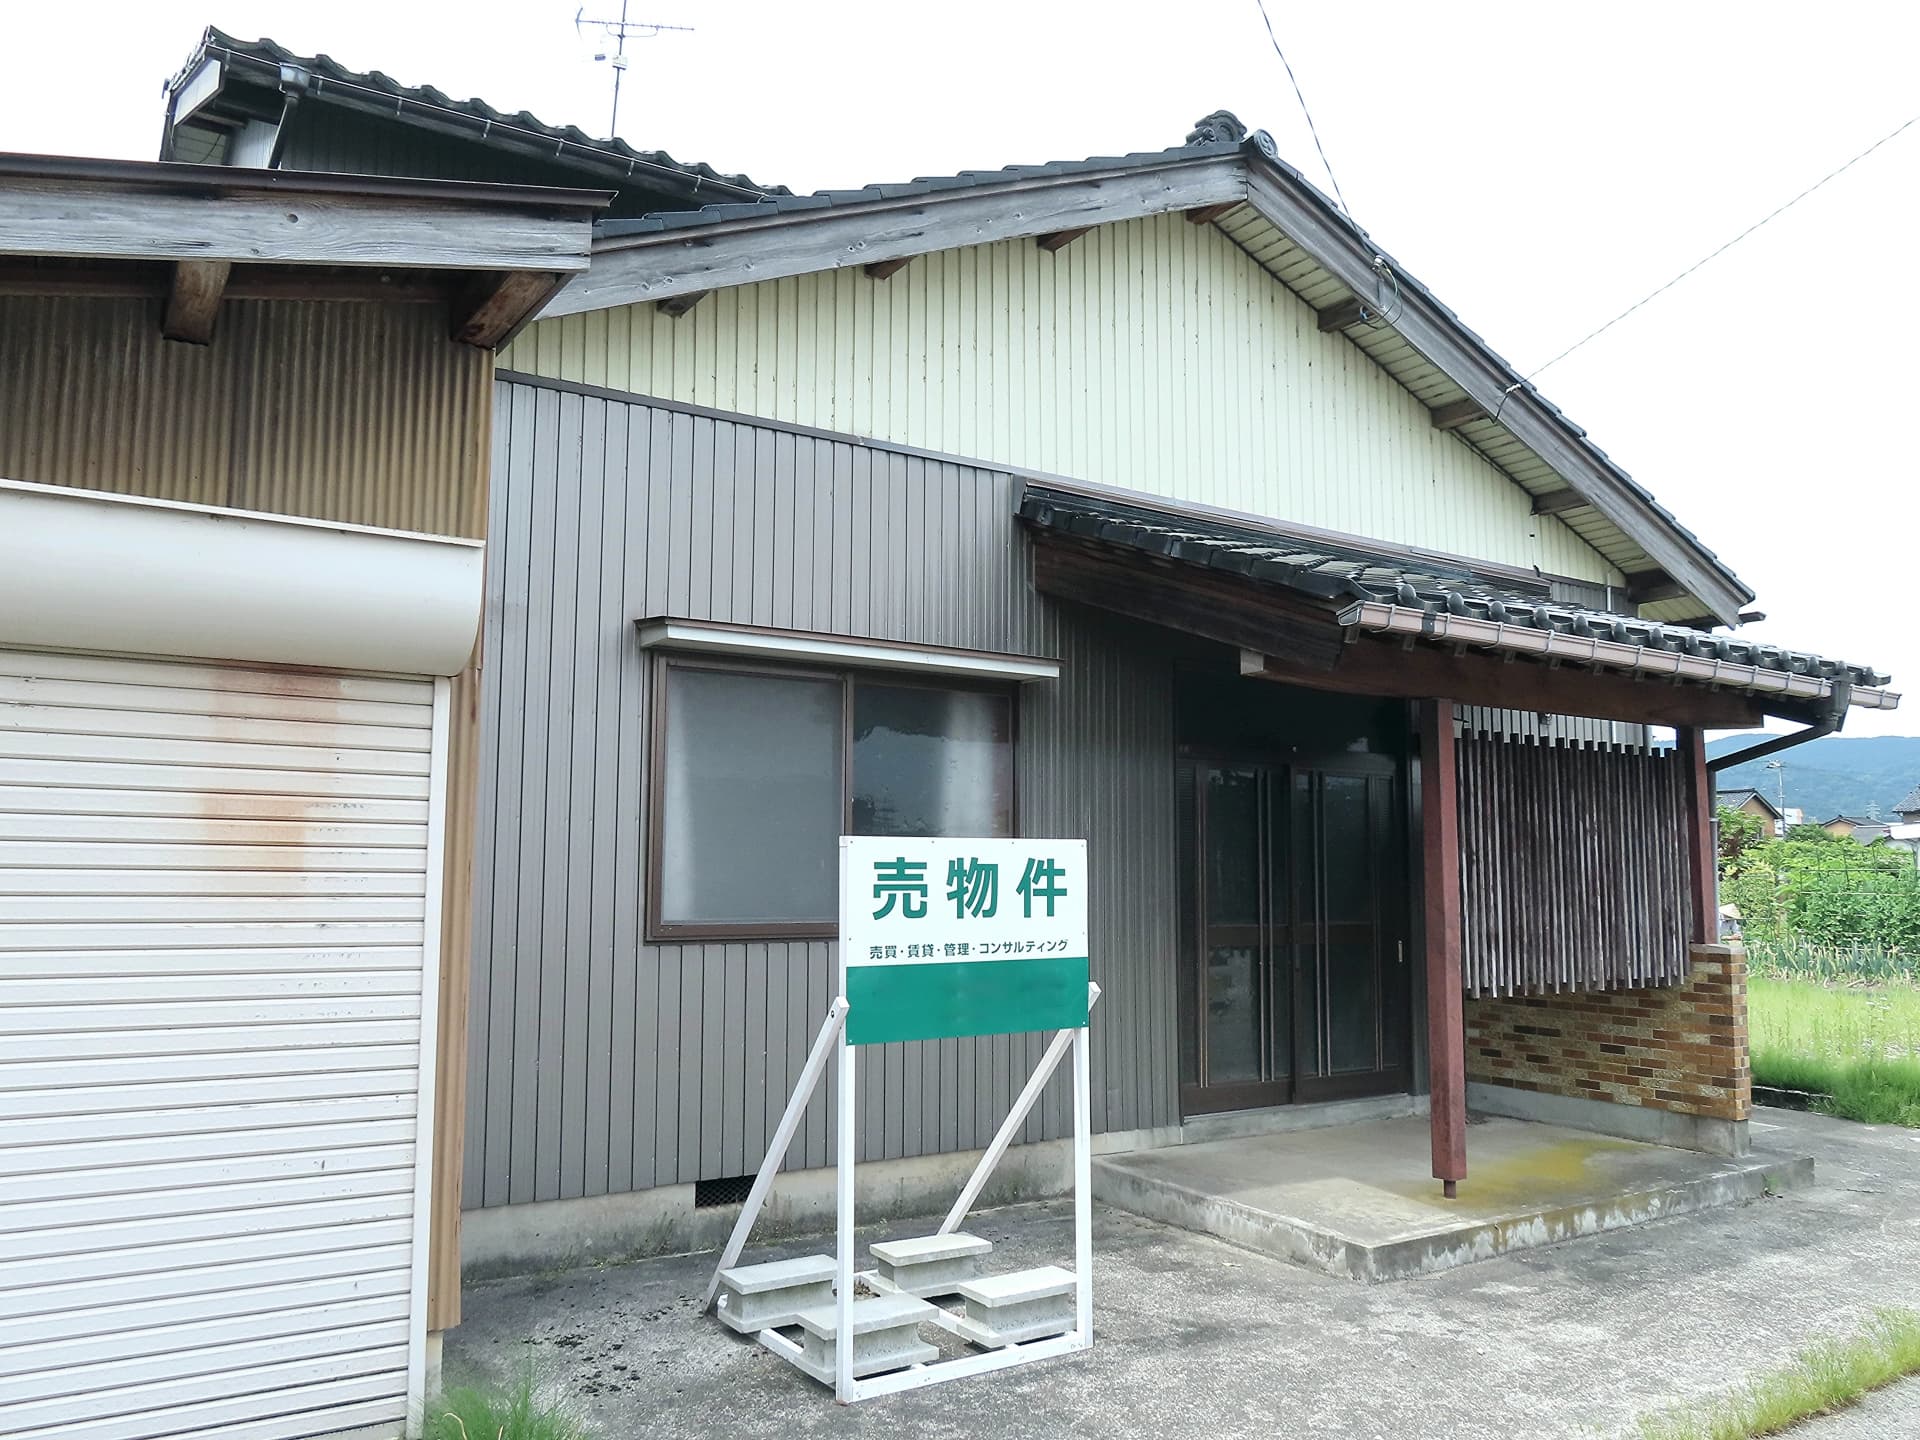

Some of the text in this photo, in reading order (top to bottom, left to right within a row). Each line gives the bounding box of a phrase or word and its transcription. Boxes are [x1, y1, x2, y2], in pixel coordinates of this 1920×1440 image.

[873, 857, 1067, 920] 売物件
[870, 939, 1068, 959] 売買・賃貸・管理・コンサルティング
